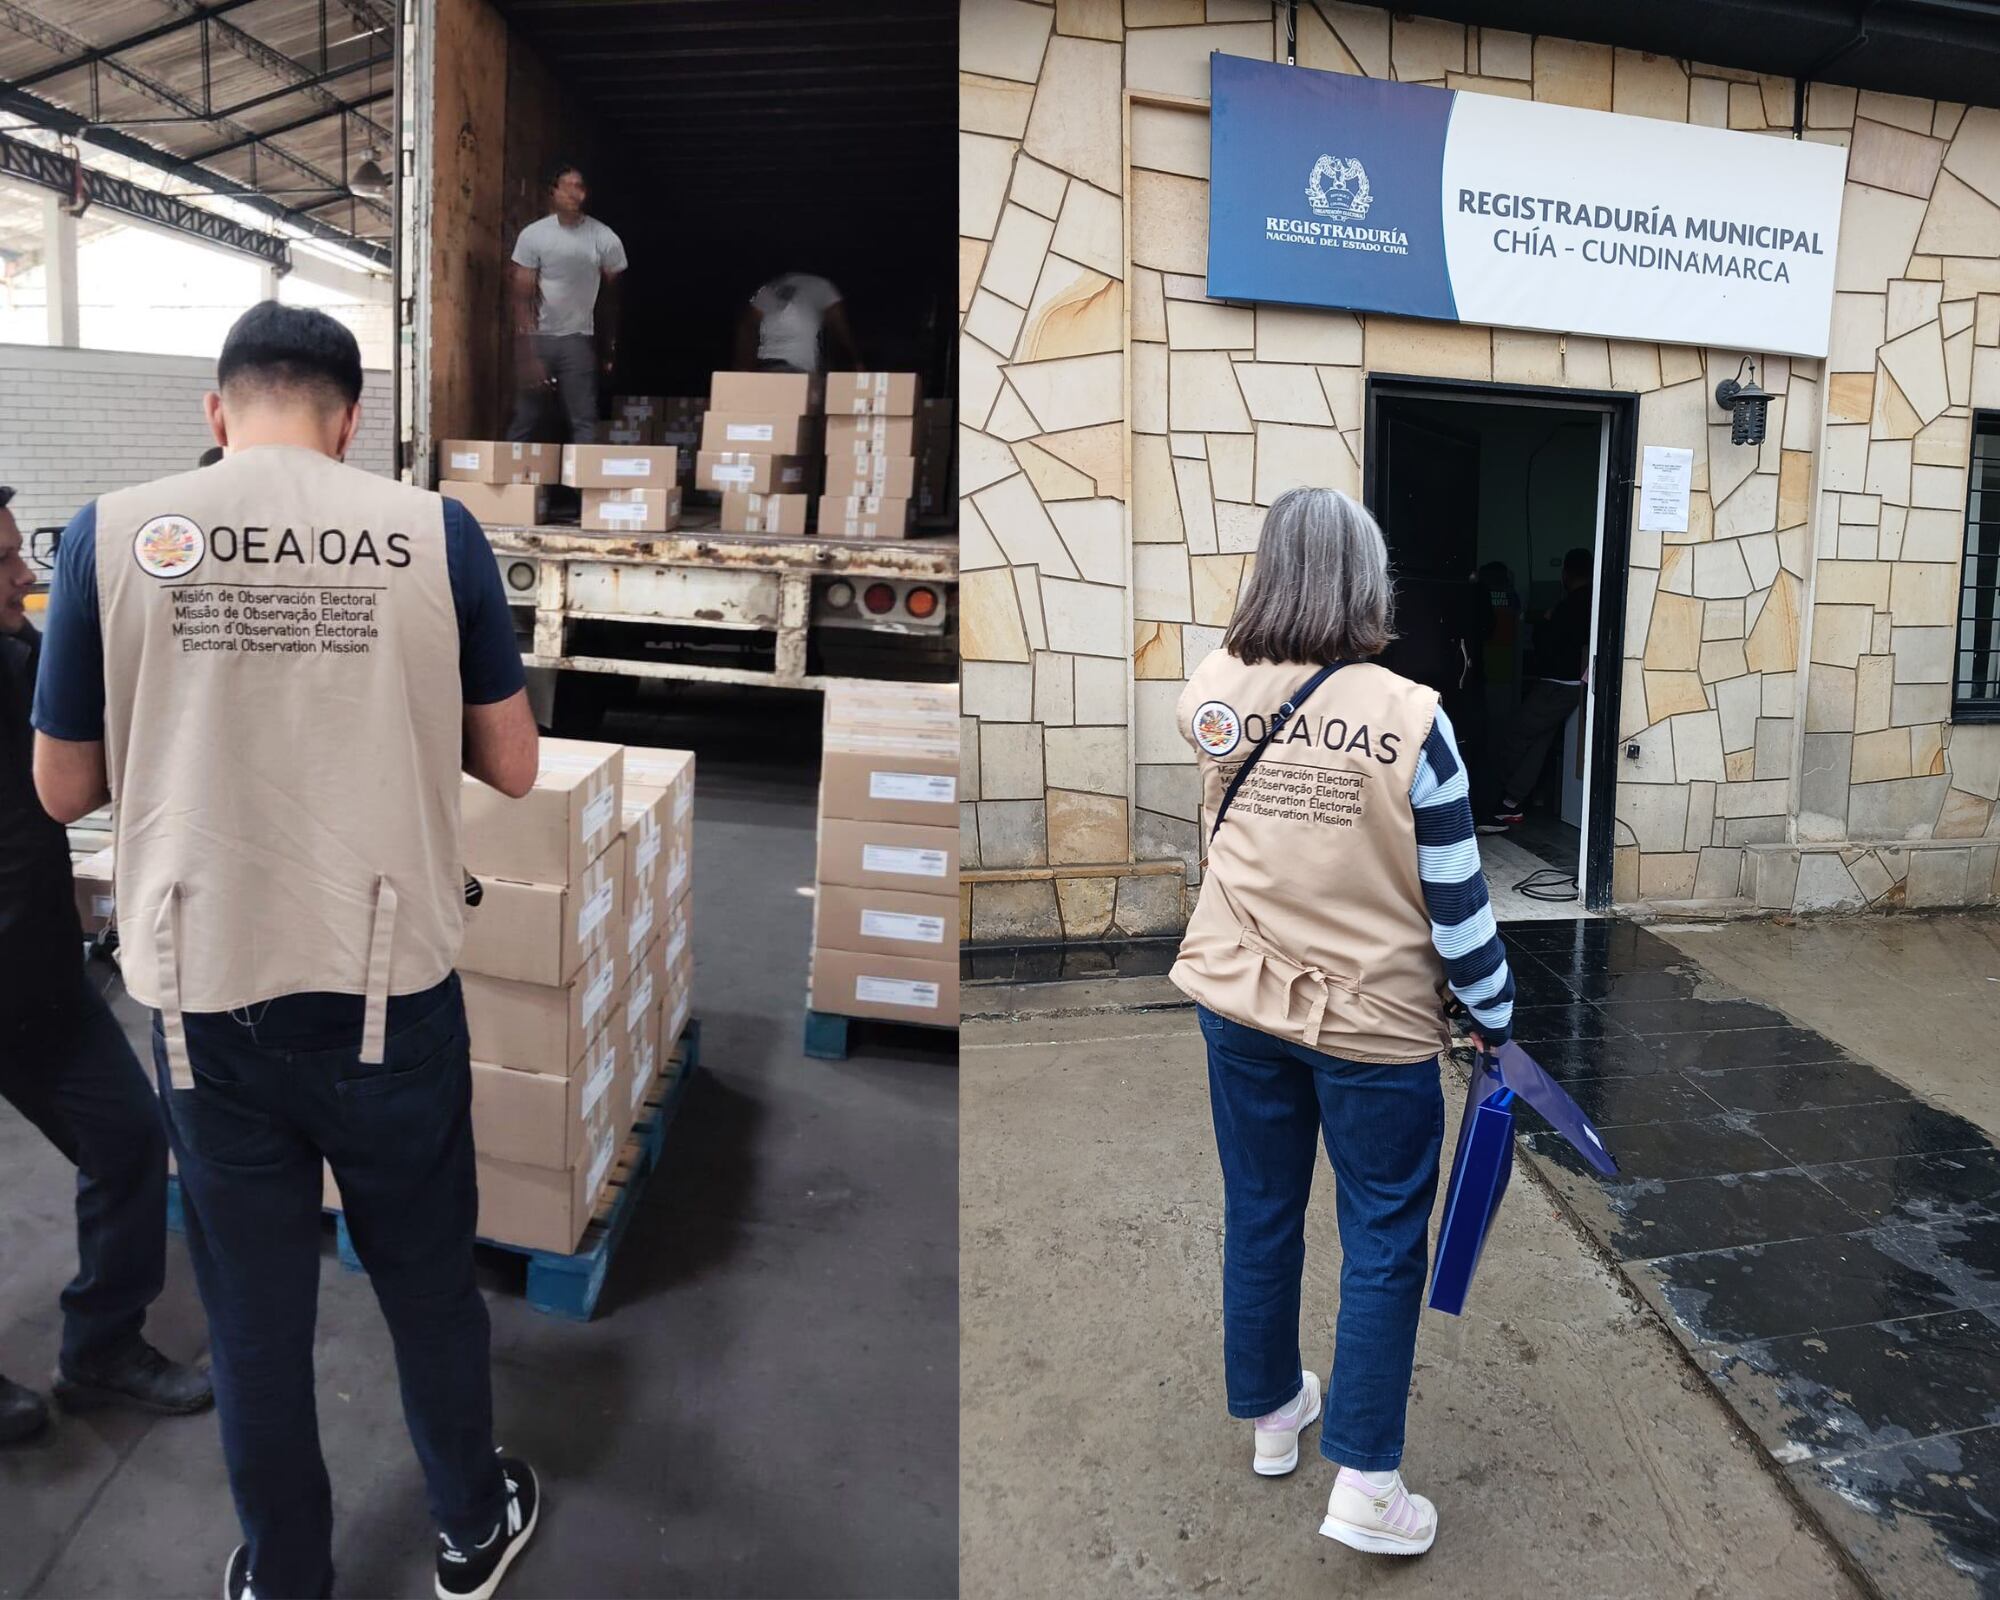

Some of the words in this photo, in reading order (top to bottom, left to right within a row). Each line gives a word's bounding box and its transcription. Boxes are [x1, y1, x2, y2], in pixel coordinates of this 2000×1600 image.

[1266, 217, 1409, 245] REGISTRADURÍA
[1458, 188, 1677, 238] REGISTRADURÍA
[1685, 216, 1824, 255] MUNICIPAL
[1266, 231, 1317, 245] NACIONAL
[1319, 237, 1340, 248] DEL
[1342, 240, 1381, 253] ESTADO
[1382, 245, 1409, 256] CIVIL
[1493, 226, 1557, 258] CHÍA
[1582, 239, 1790, 284] CUNDINAMARCA
[209, 525, 306, 564] OEA
[318, 528, 412, 568] OAS
[172, 588, 214, 604] Misión
[218, 589, 234, 603] de
[238, 590, 316, 606] Observación
[320, 591, 377, 606] Electoral
[175, 605, 219, 620] Missão
[224, 606, 239, 619] de
[243, 606, 317, 624] Observação
[321, 607, 375, 622] Eleitoral
[172, 621, 220, 636] Mission
[315, 621, 379, 638] Électorale
[182, 638, 239, 652] Electoral
[241, 638, 317, 653] Observation
[321, 639, 370, 654] Mission
[1323, 718, 1402, 765] OAS
[1317, 771, 1364, 788] Electoral
[1316, 785, 1360, 802] Eleitoral
[1253, 803, 1310, 821] Observation
[1313, 811, 1353, 827] Mission
[1309, 795, 1362, 815] Électorale
